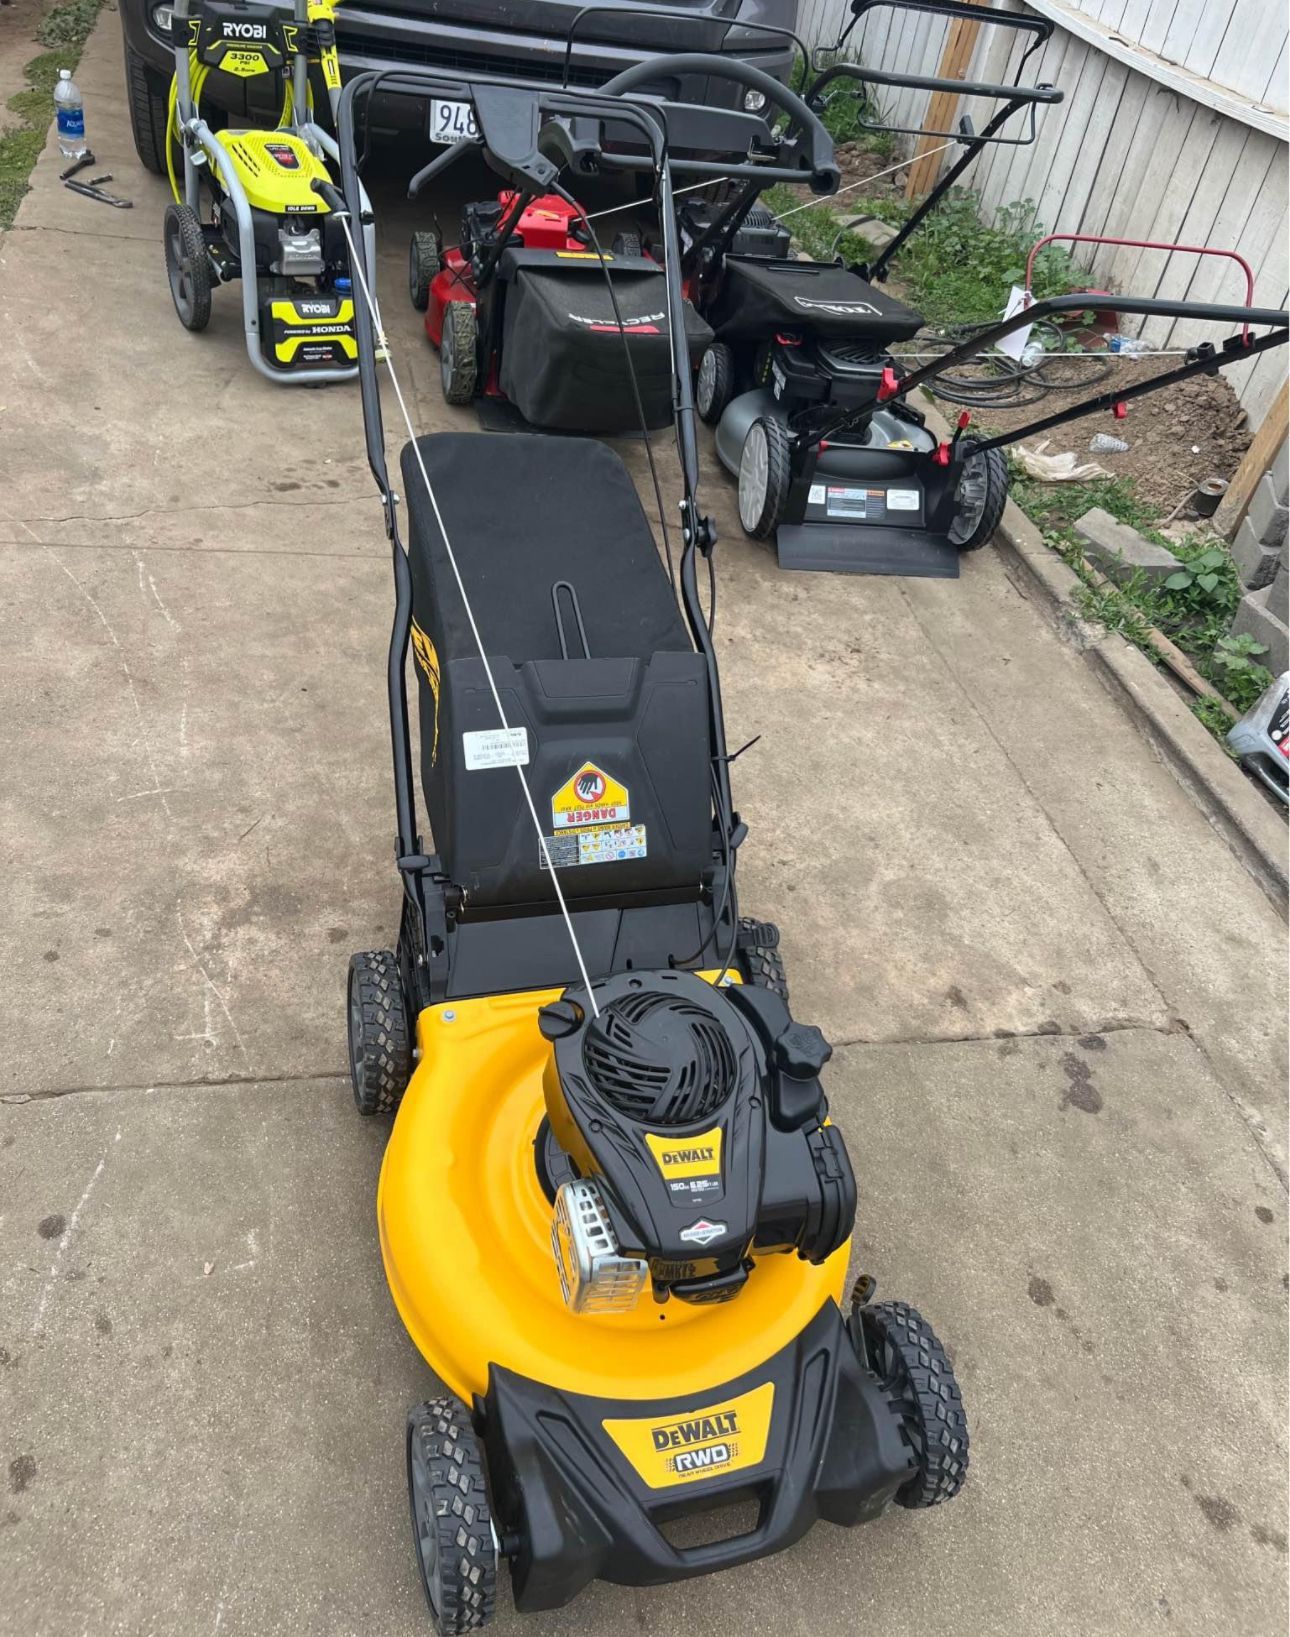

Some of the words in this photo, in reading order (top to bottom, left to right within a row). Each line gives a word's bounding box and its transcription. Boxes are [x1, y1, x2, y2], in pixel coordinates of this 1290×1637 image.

[222, 22, 267, 39] RYOBI
[230, 53, 260, 61] 3300
[301, 304, 331, 313] RYOBI
[312, 325, 352, 334] HONDA
[566, 807, 617, 823] DANGER
[675, 1446, 729, 1471] RWD
